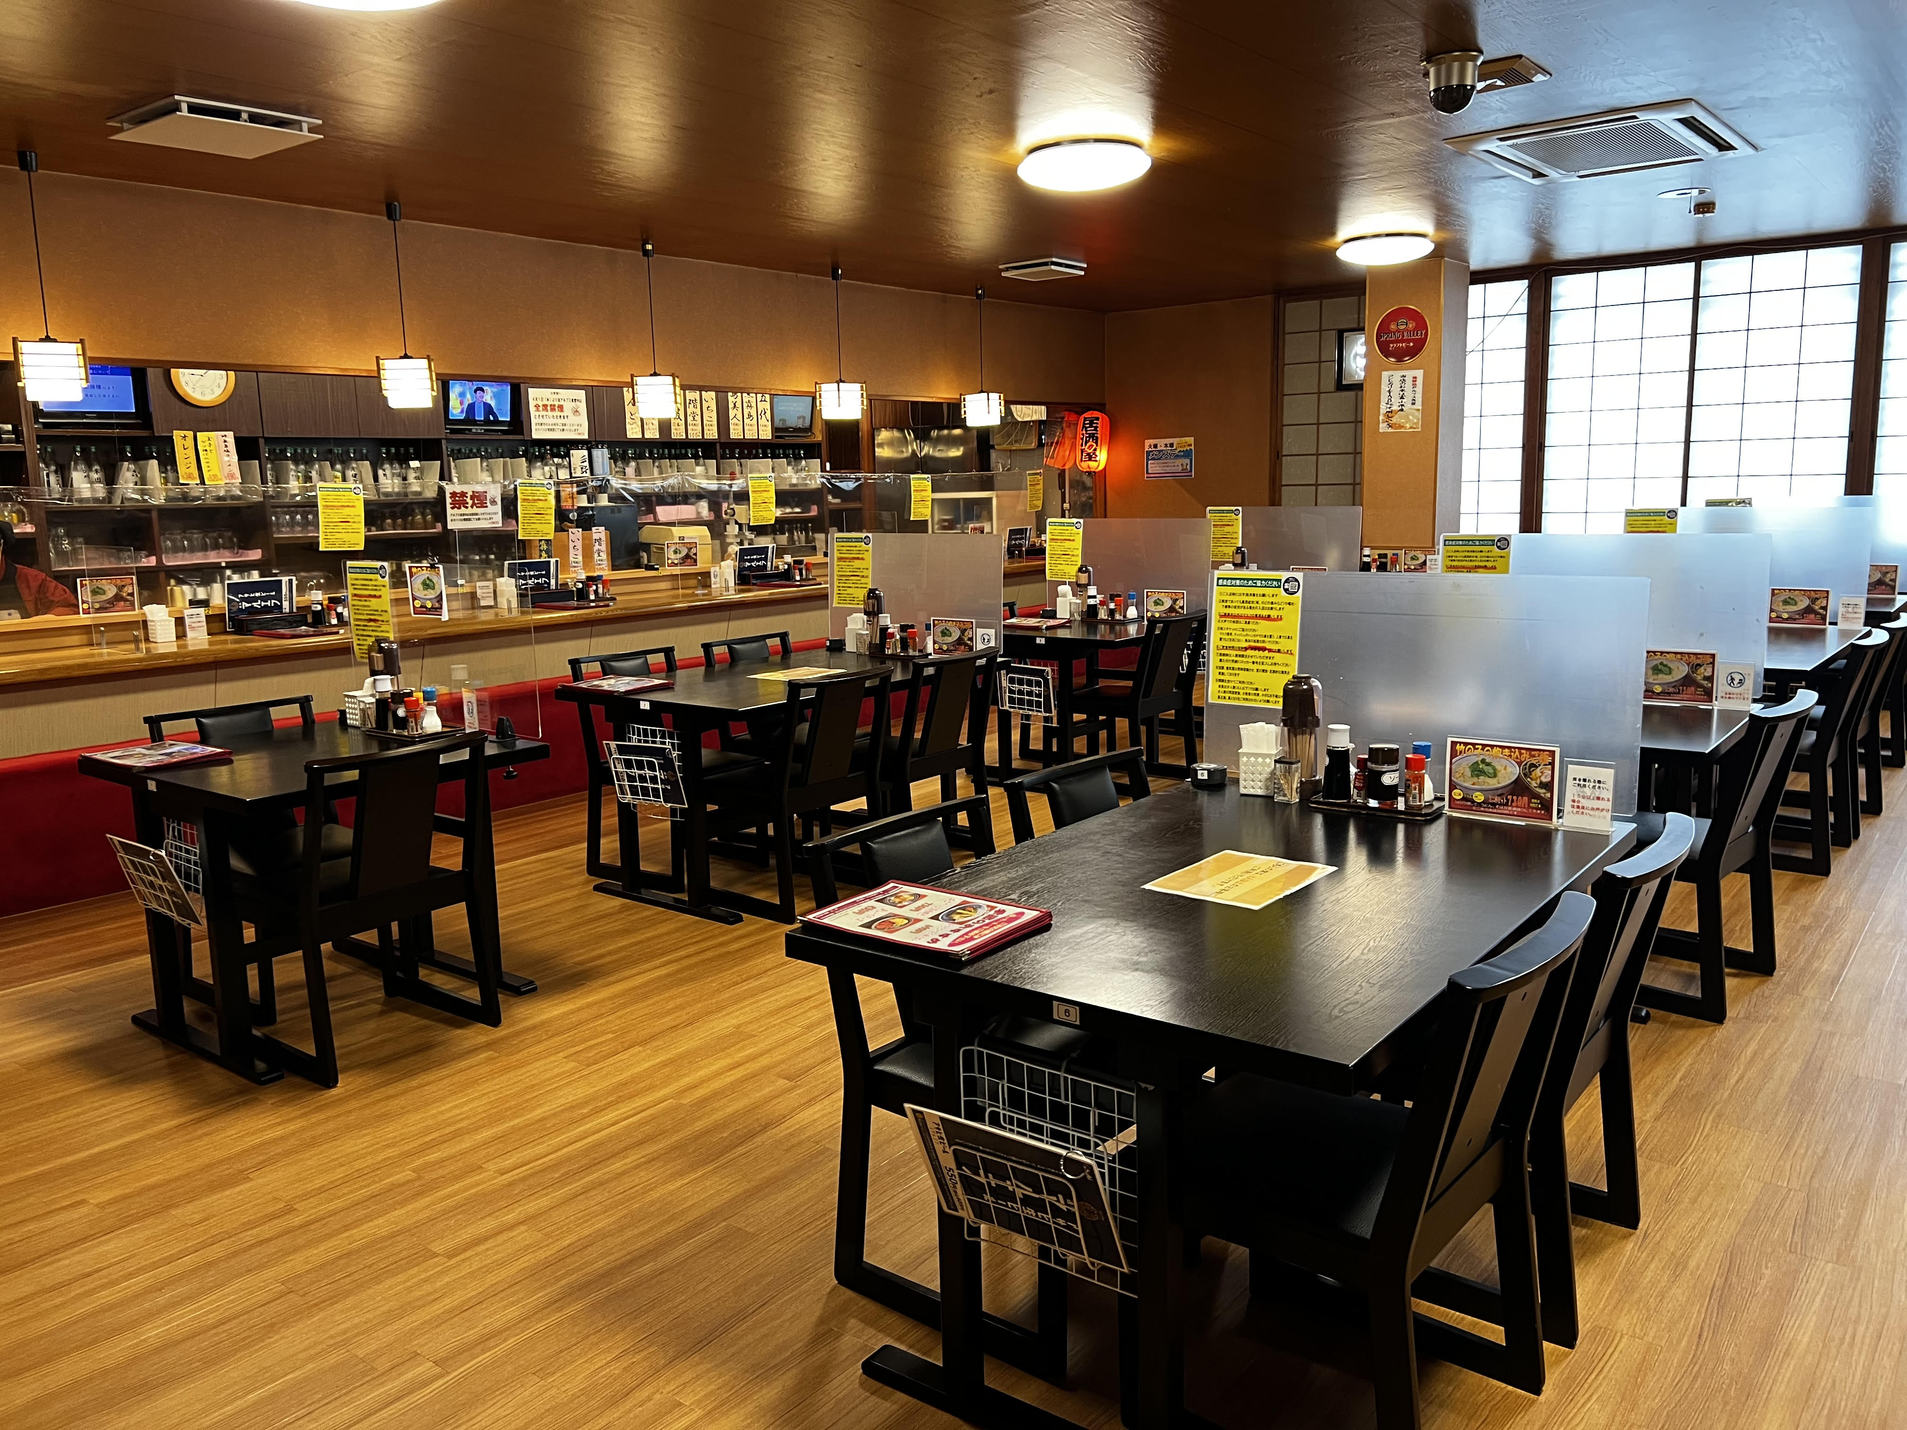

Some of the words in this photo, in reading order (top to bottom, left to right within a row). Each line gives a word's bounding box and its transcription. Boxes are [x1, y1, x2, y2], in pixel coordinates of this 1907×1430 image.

[534, 403, 564, 413] 全席禁煙
[1080, 416, 1100, 462] 居酒屋
[180, 433, 192, 470] オレンジ
[449, 490, 488, 510] 禁煙
[570, 529, 580, 560] いいちこ
[593, 528, 604, 557] 二階堂
[1218, 578, 1281, 588] 感染症対策のためご協力ください
[238, 599, 281, 610] マルエフ
[1455, 743, 1550, 763] 竹の子の炊き込みご飯
[1572, 782, 1609, 791] ご利用ください。
